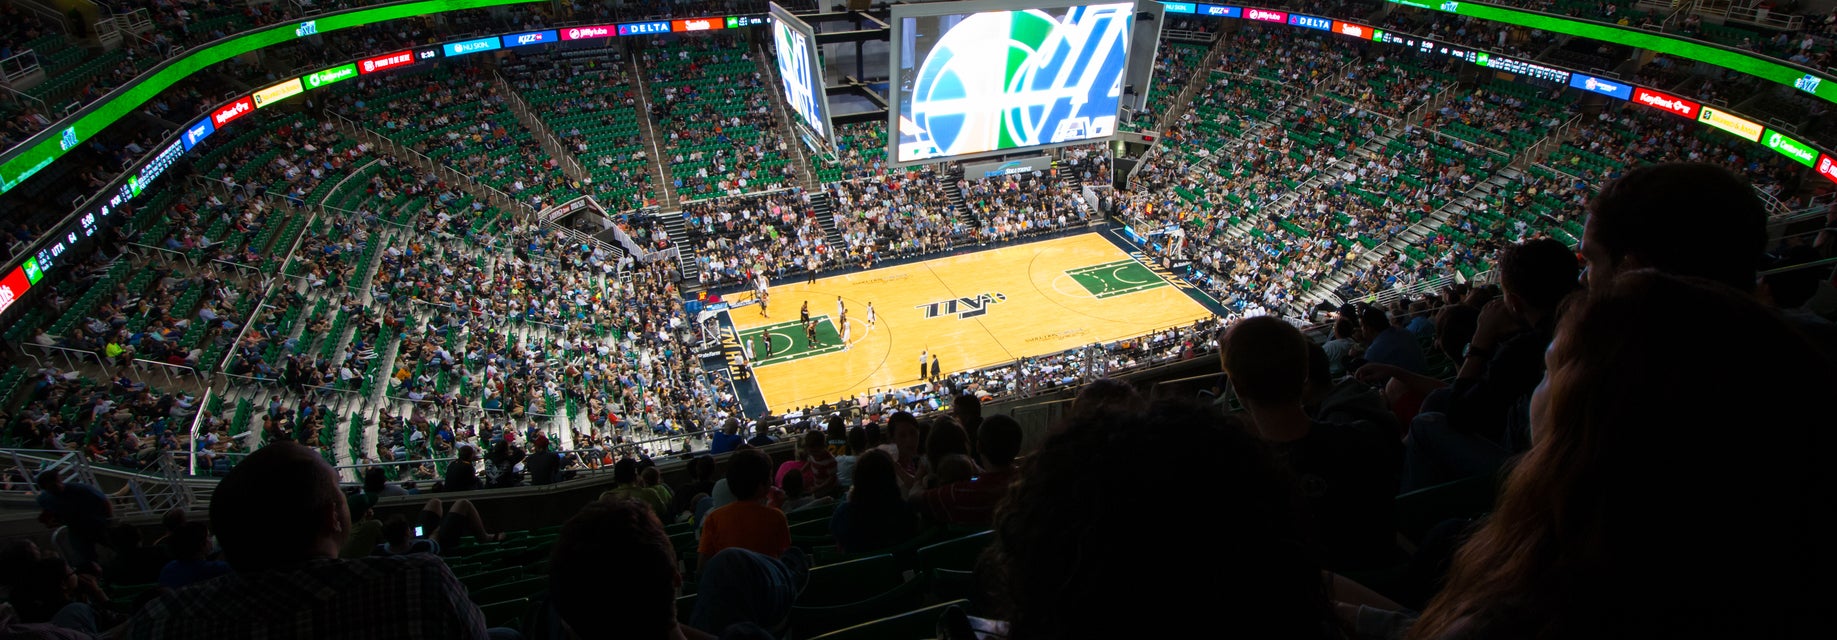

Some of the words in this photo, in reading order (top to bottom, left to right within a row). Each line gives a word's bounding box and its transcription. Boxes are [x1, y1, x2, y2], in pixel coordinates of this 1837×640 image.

[630, 20, 669, 33] DELTA
[1299, 17, 1330, 29] DELTA
[1640, 92, 1674, 110] KeyBank
[51, 242, 66, 257] UTA
[68, 231, 78, 244] 64
[110, 194, 122, 208] POR
[1155, 271, 1195, 290] JAZZ
